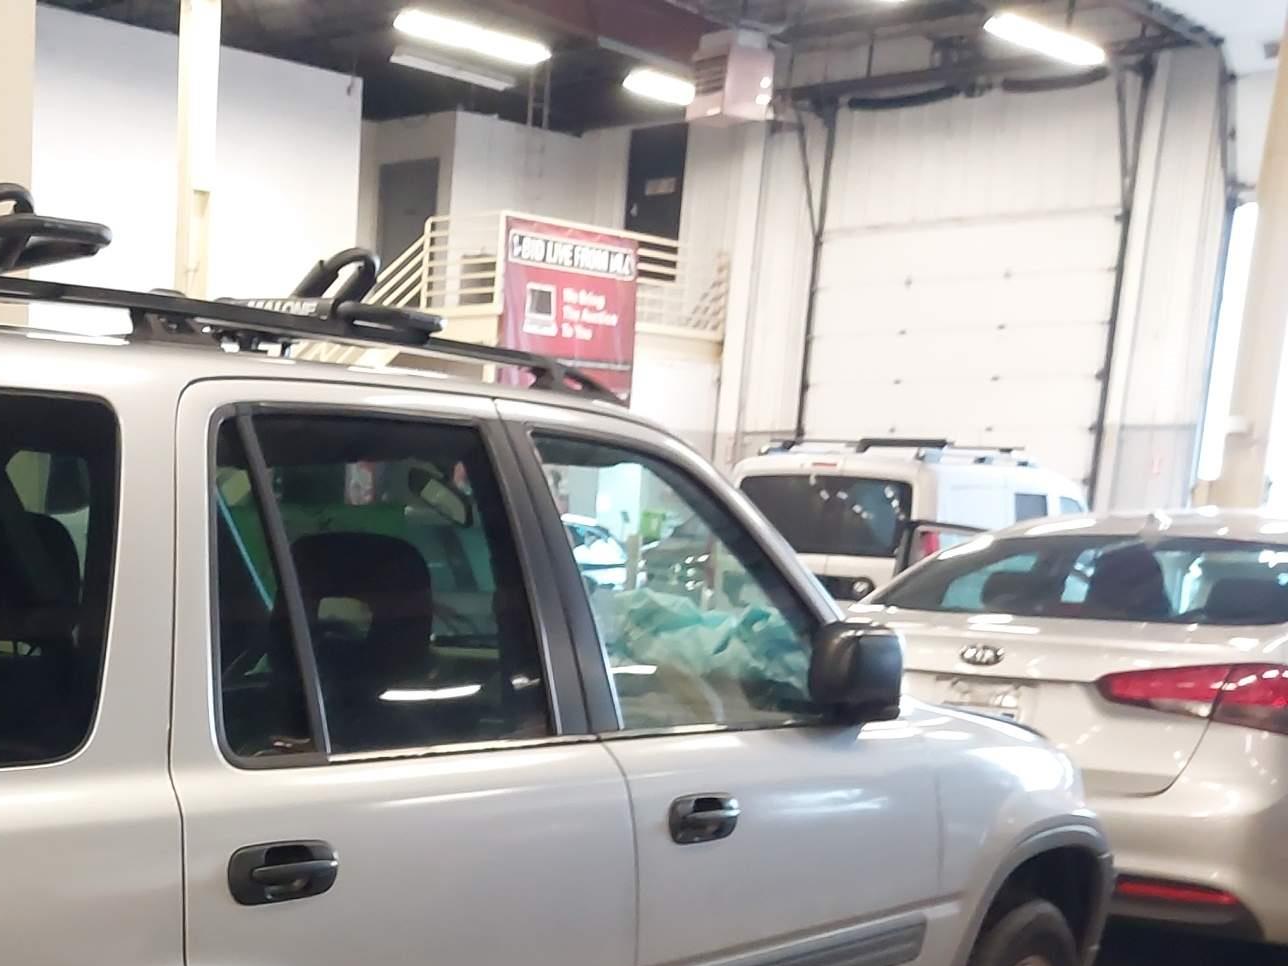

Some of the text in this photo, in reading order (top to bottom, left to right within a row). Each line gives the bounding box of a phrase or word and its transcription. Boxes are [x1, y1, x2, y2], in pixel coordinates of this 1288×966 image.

[546, 239, 574, 268] LIVE
[574, 245, 610, 273] FROM
[961, 646, 1002, 665] KIA
